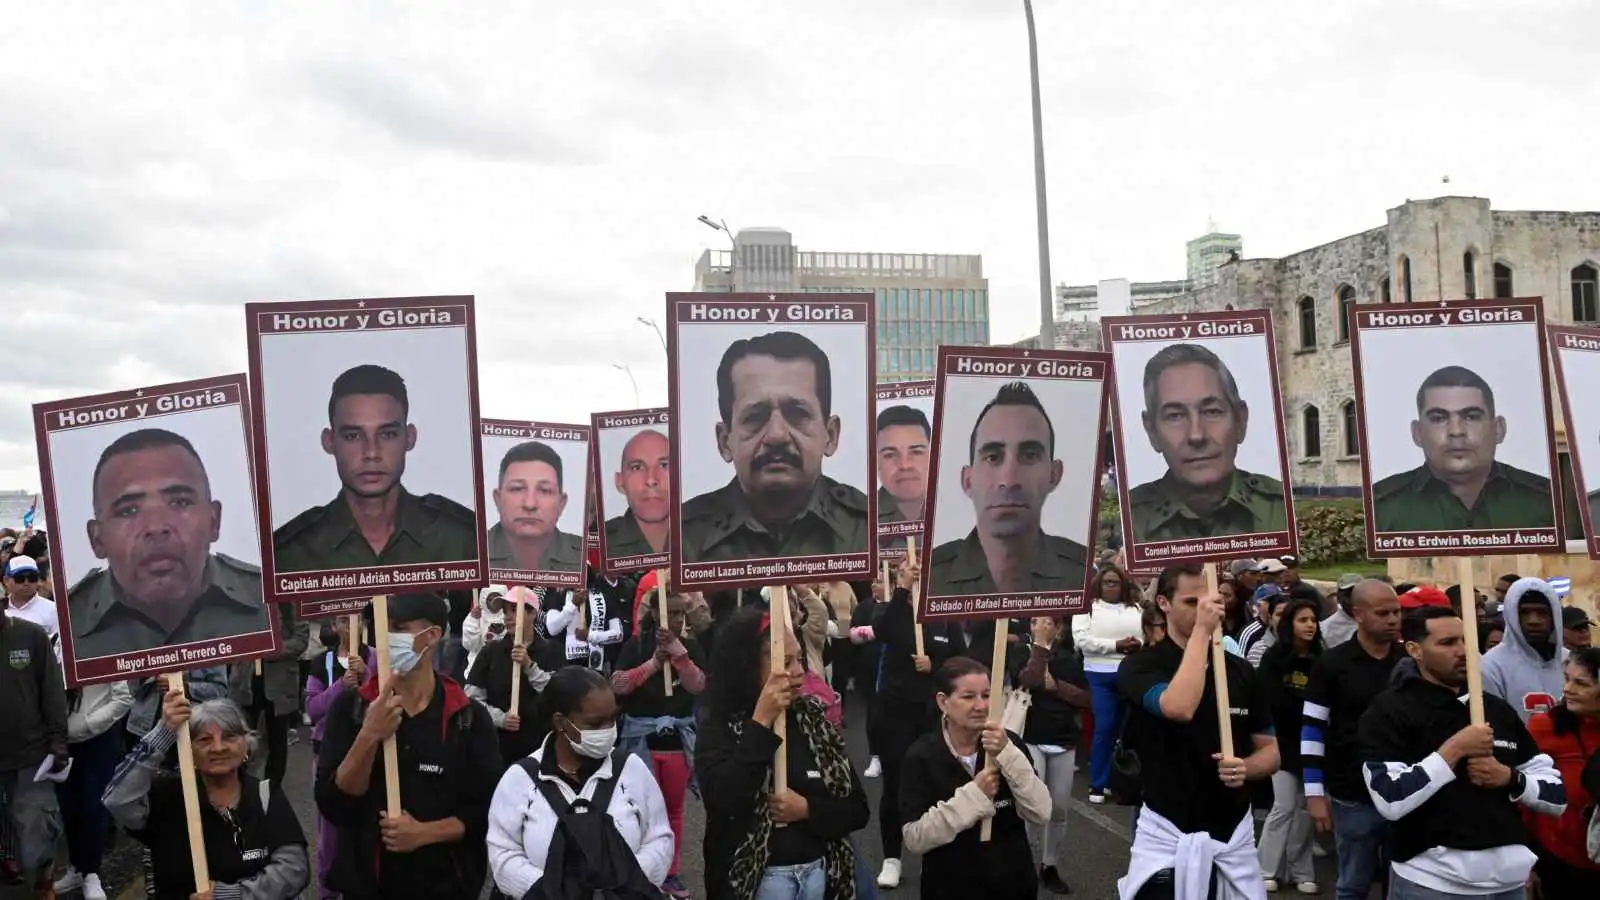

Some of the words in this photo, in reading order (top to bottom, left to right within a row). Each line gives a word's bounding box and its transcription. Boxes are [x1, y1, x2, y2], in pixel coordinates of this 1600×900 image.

[273, 313, 348, 330] Honor
[356, 314, 369, 330] y
[378, 308, 451, 326] Gloria
[690, 304, 757, 320] Honor
[766, 307, 778, 323] y
[787, 304, 854, 320] Gloria
[1369, 311, 1432, 326] Honor
[1439, 312, 1451, 325] y
[1458, 308, 1523, 323] Gloria
[1121, 323, 1175, 339] Honor
[1181, 327, 1191, 338] y
[1197, 320, 1254, 336] Gloria
[1564, 335, 1600, 350] Hon
[957, 358, 1013, 375] Honor
[1020, 363, 1030, 377] y
[1036, 361, 1093, 377] Gloria
[905, 387, 936, 397] Glori
[58, 408, 128, 427] Honor
[136, 403, 149, 418] y
[156, 390, 226, 411] Gloria
[604, 416, 644, 427] Honor
[648, 416, 655, 425] y
[484, 424, 524, 436] Honor
[529, 430, 537, 438] y
[540, 429, 581, 440] Gloria
[1418, 535, 1460, 546] Erdwin
[1462, 533, 1511, 545] Rosabal
[1514, 530, 1555, 544] Ávalos
[1145, 547, 1170, 557] Coronel
[1171, 543, 1203, 554] Humberto
[1205, 541, 1229, 551] Alfonso
[1230, 539, 1248, 549] Roca
[281, 577, 319, 592] Capitán
[321, 573, 357, 588] Addriel
[359, 571, 391, 585] Adrián
[393, 568, 437, 583] Socarrás
[438, 567, 477, 580] Tamayo
[500, 571, 512, 579] Luis
[513, 572, 534, 580] Manuel
[560, 574, 579, 582] Castro
[684, 566, 716, 579] Coronel
[718, 566, 745, 576] Lazaro
[747, 562, 786, 576] Evangelio
[930, 600, 963, 612] Soldado
[964, 600, 974, 611] (r)
[975, 597, 1000, 609] Rafael
[1002, 597, 1032, 609] Enrique
[1033, 595, 1063, 607] Moreno
[1064, 593, 1082, 605] Font
[594, 596, 604, 632] MIAMI
[116, 658, 146, 672] Mayor
[147, 653, 180, 667] Ismael
[180, 647, 216, 662] Terrero
[218, 643, 233, 655] Ge
